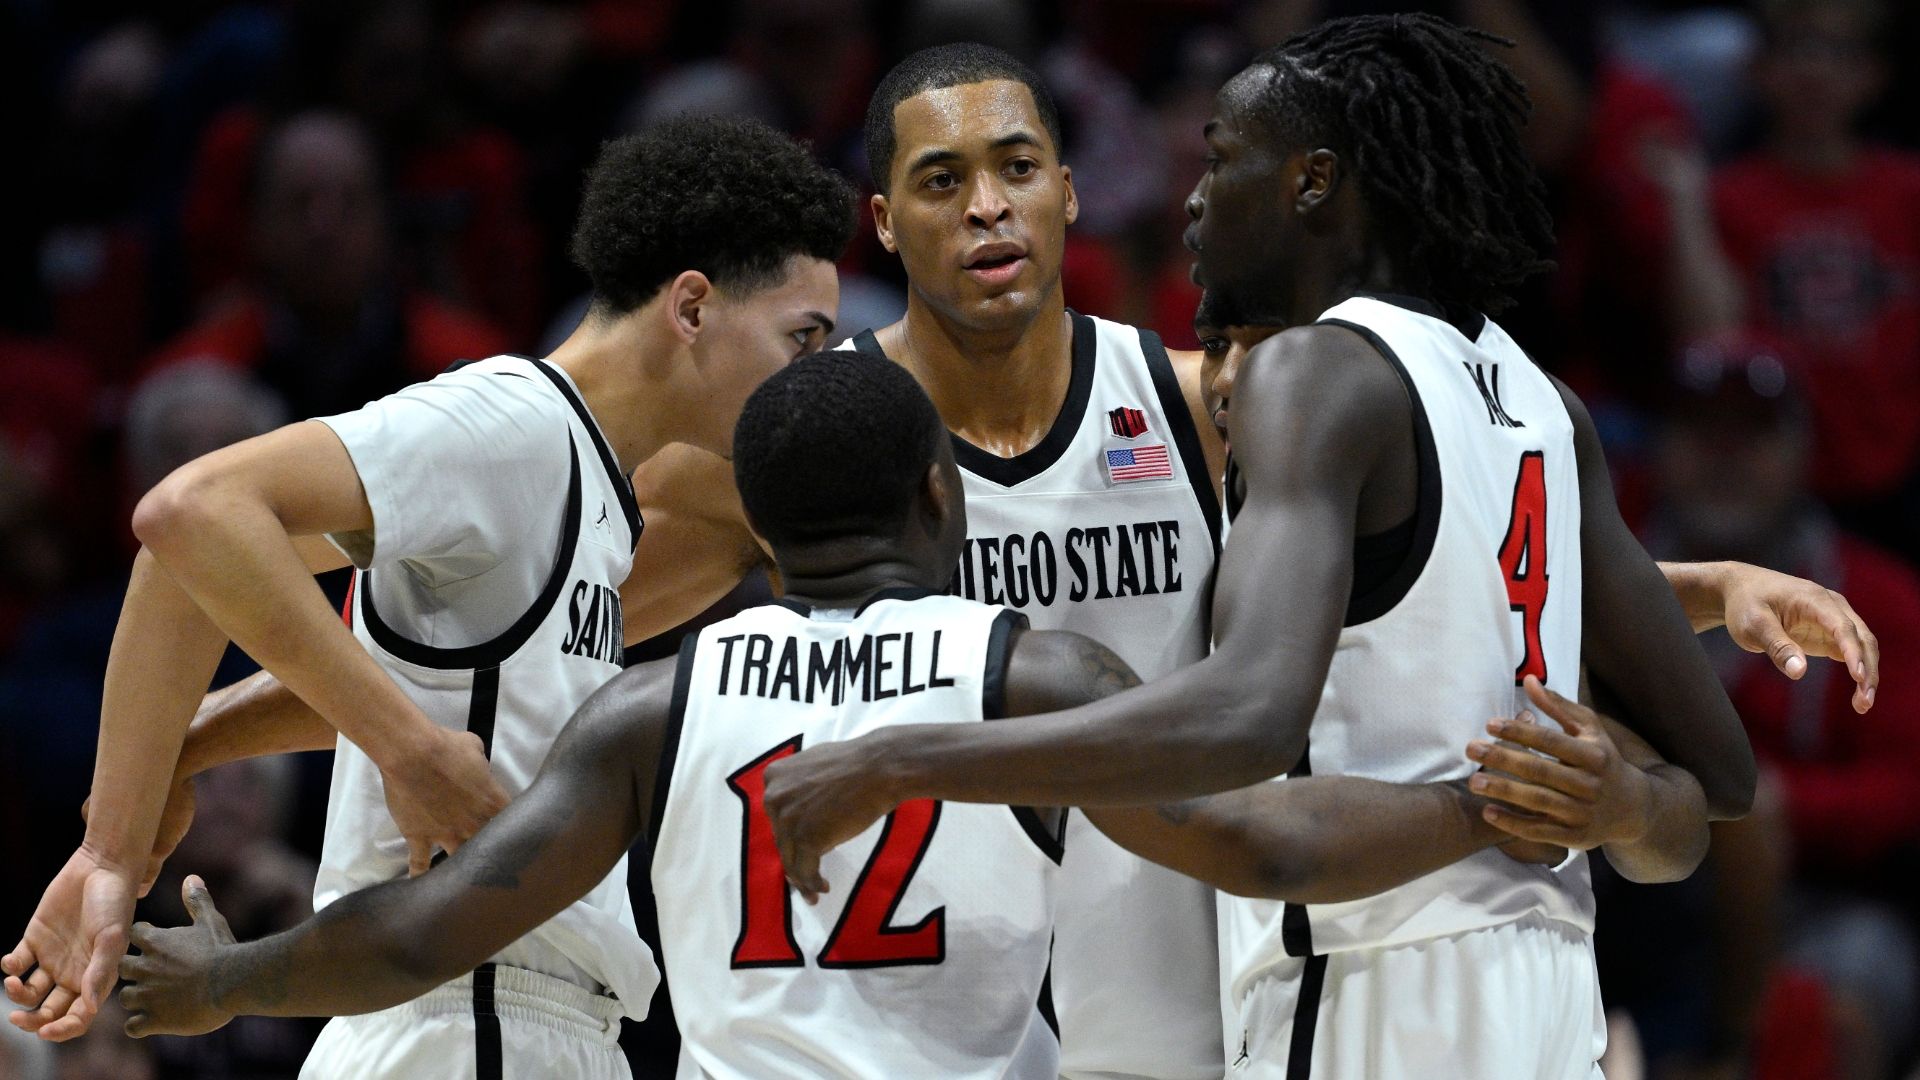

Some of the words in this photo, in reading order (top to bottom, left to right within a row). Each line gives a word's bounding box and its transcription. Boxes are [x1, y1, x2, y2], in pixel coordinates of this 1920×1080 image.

[1065, 520, 1182, 602] STATE
[1497, 450, 1550, 687] 4
[717, 630, 955, 706] TRAMMELL
[727, 733, 947, 970] 12
